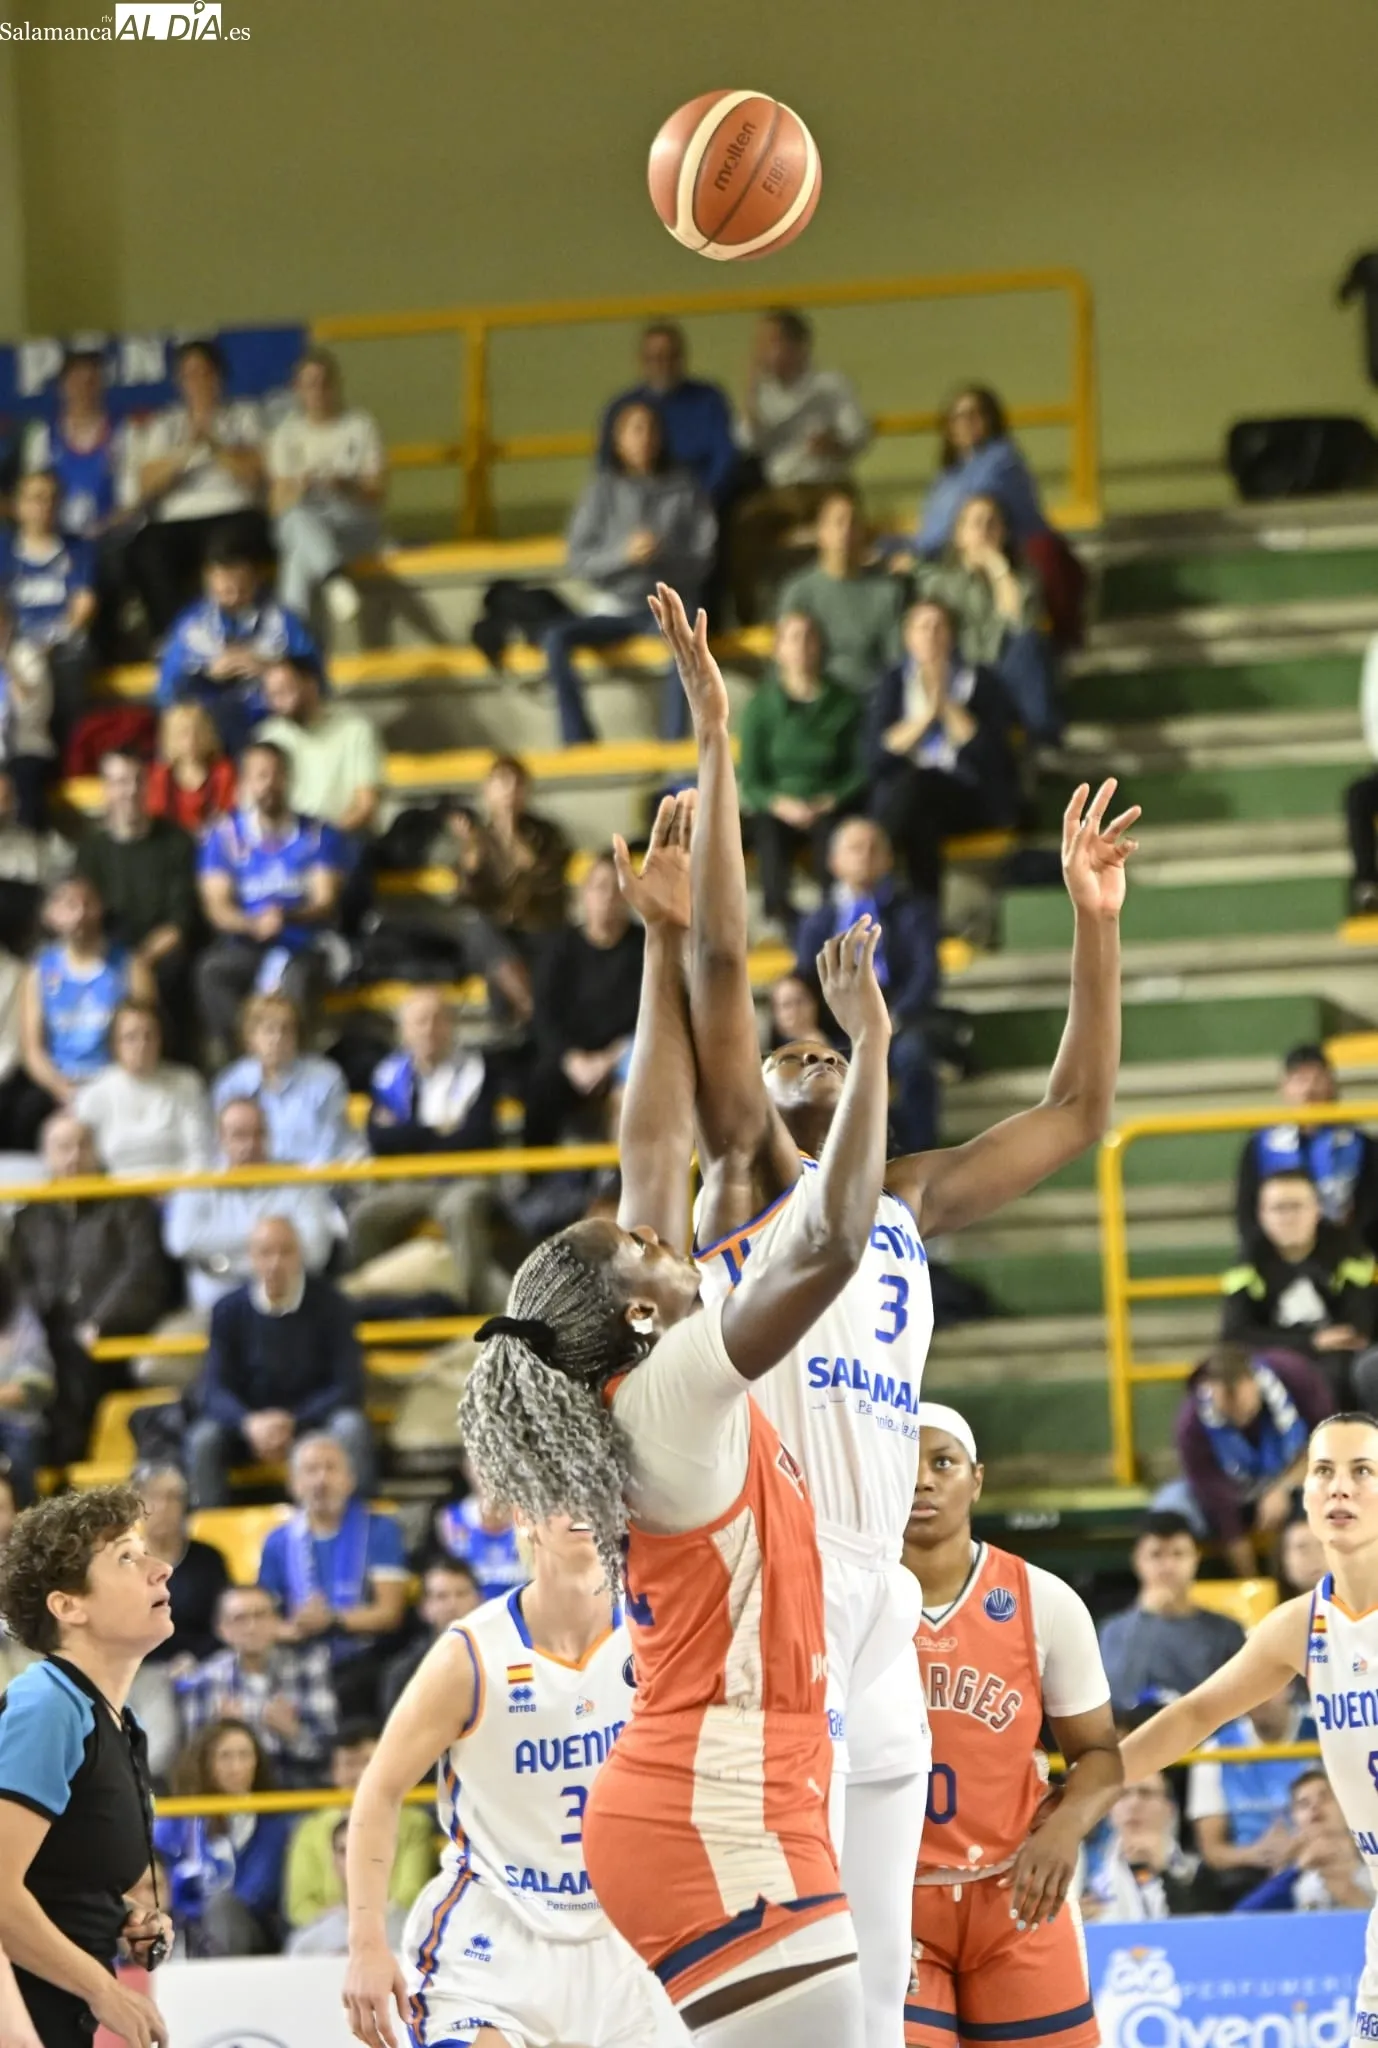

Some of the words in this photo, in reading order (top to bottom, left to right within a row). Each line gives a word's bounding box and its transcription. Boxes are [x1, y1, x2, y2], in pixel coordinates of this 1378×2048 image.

[713, 121, 757, 192] molten
[875, 1273, 910, 1344] 3
[508, 1703, 537, 1714] errea
[927, 1662, 1023, 1731] RGES
[1315, 1688, 1378, 1731] AVEN
